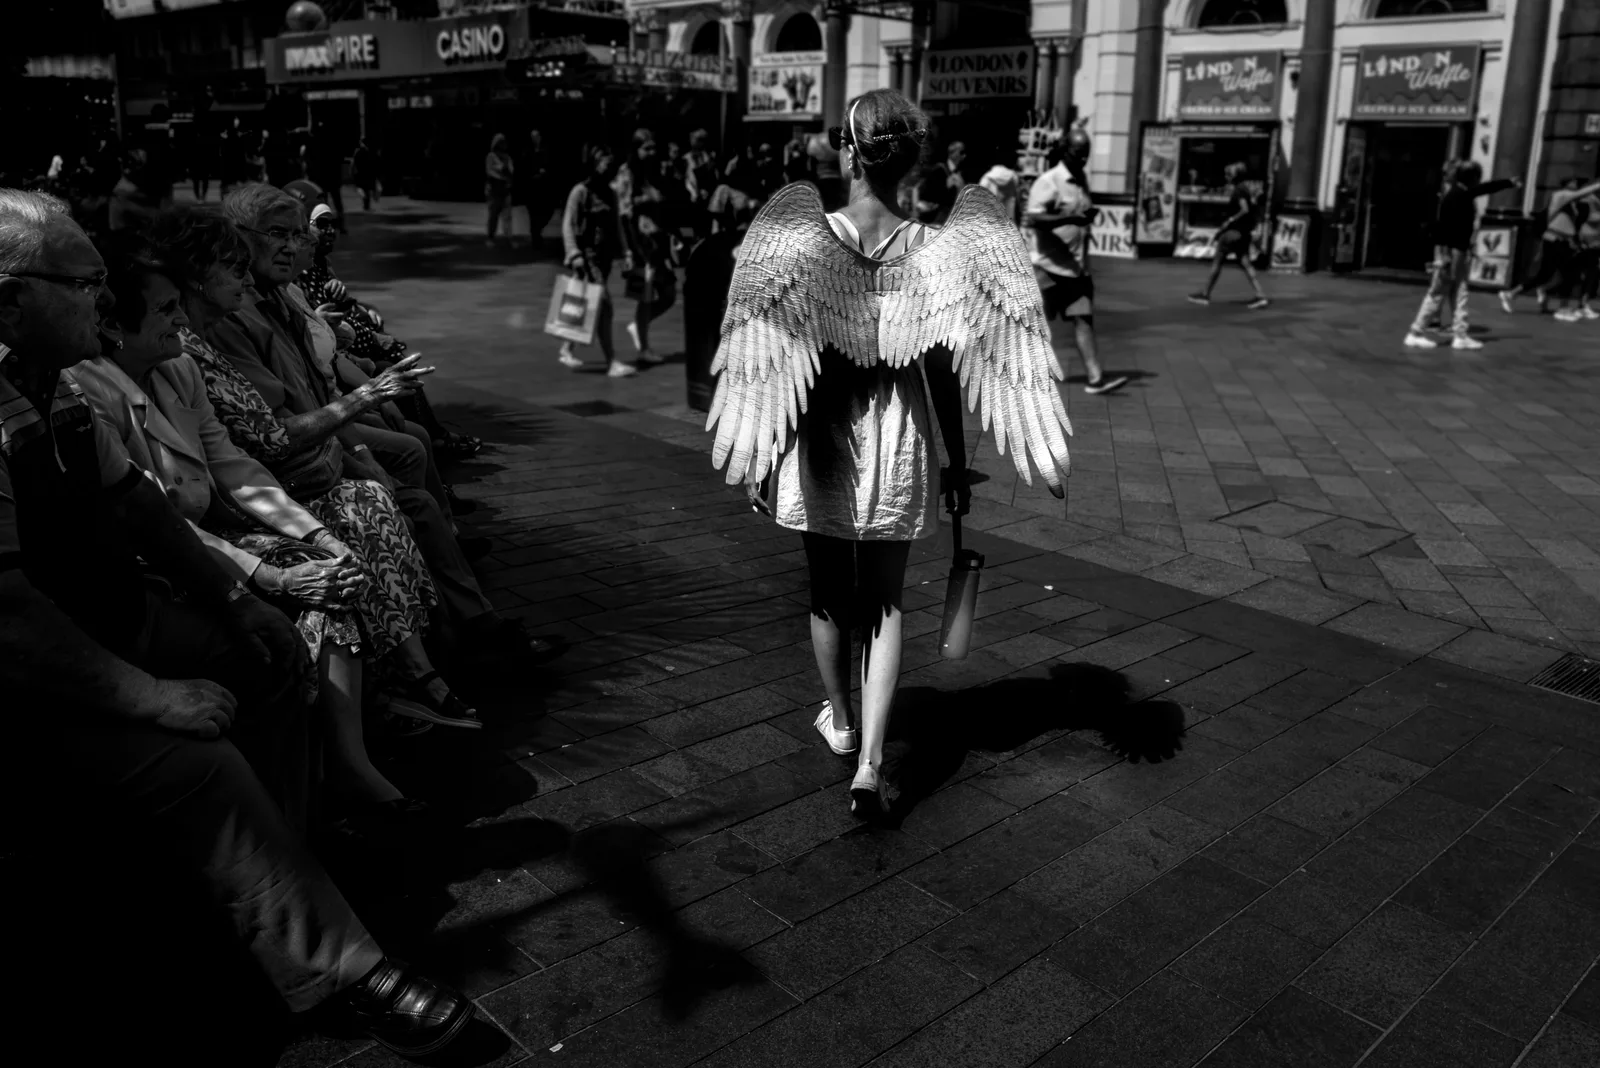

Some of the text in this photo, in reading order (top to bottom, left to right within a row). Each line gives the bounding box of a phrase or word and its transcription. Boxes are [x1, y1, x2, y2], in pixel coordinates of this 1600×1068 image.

[325, 33, 376, 65] PIRE
[435, 24, 505, 60] CASINO
[940, 53, 1015, 73] LONDON
[929, 76, 1028, 95] SOUVENIRS
[1404, 62, 1471, 91] Waffle
[1088, 232, 1133, 252] NIRS
